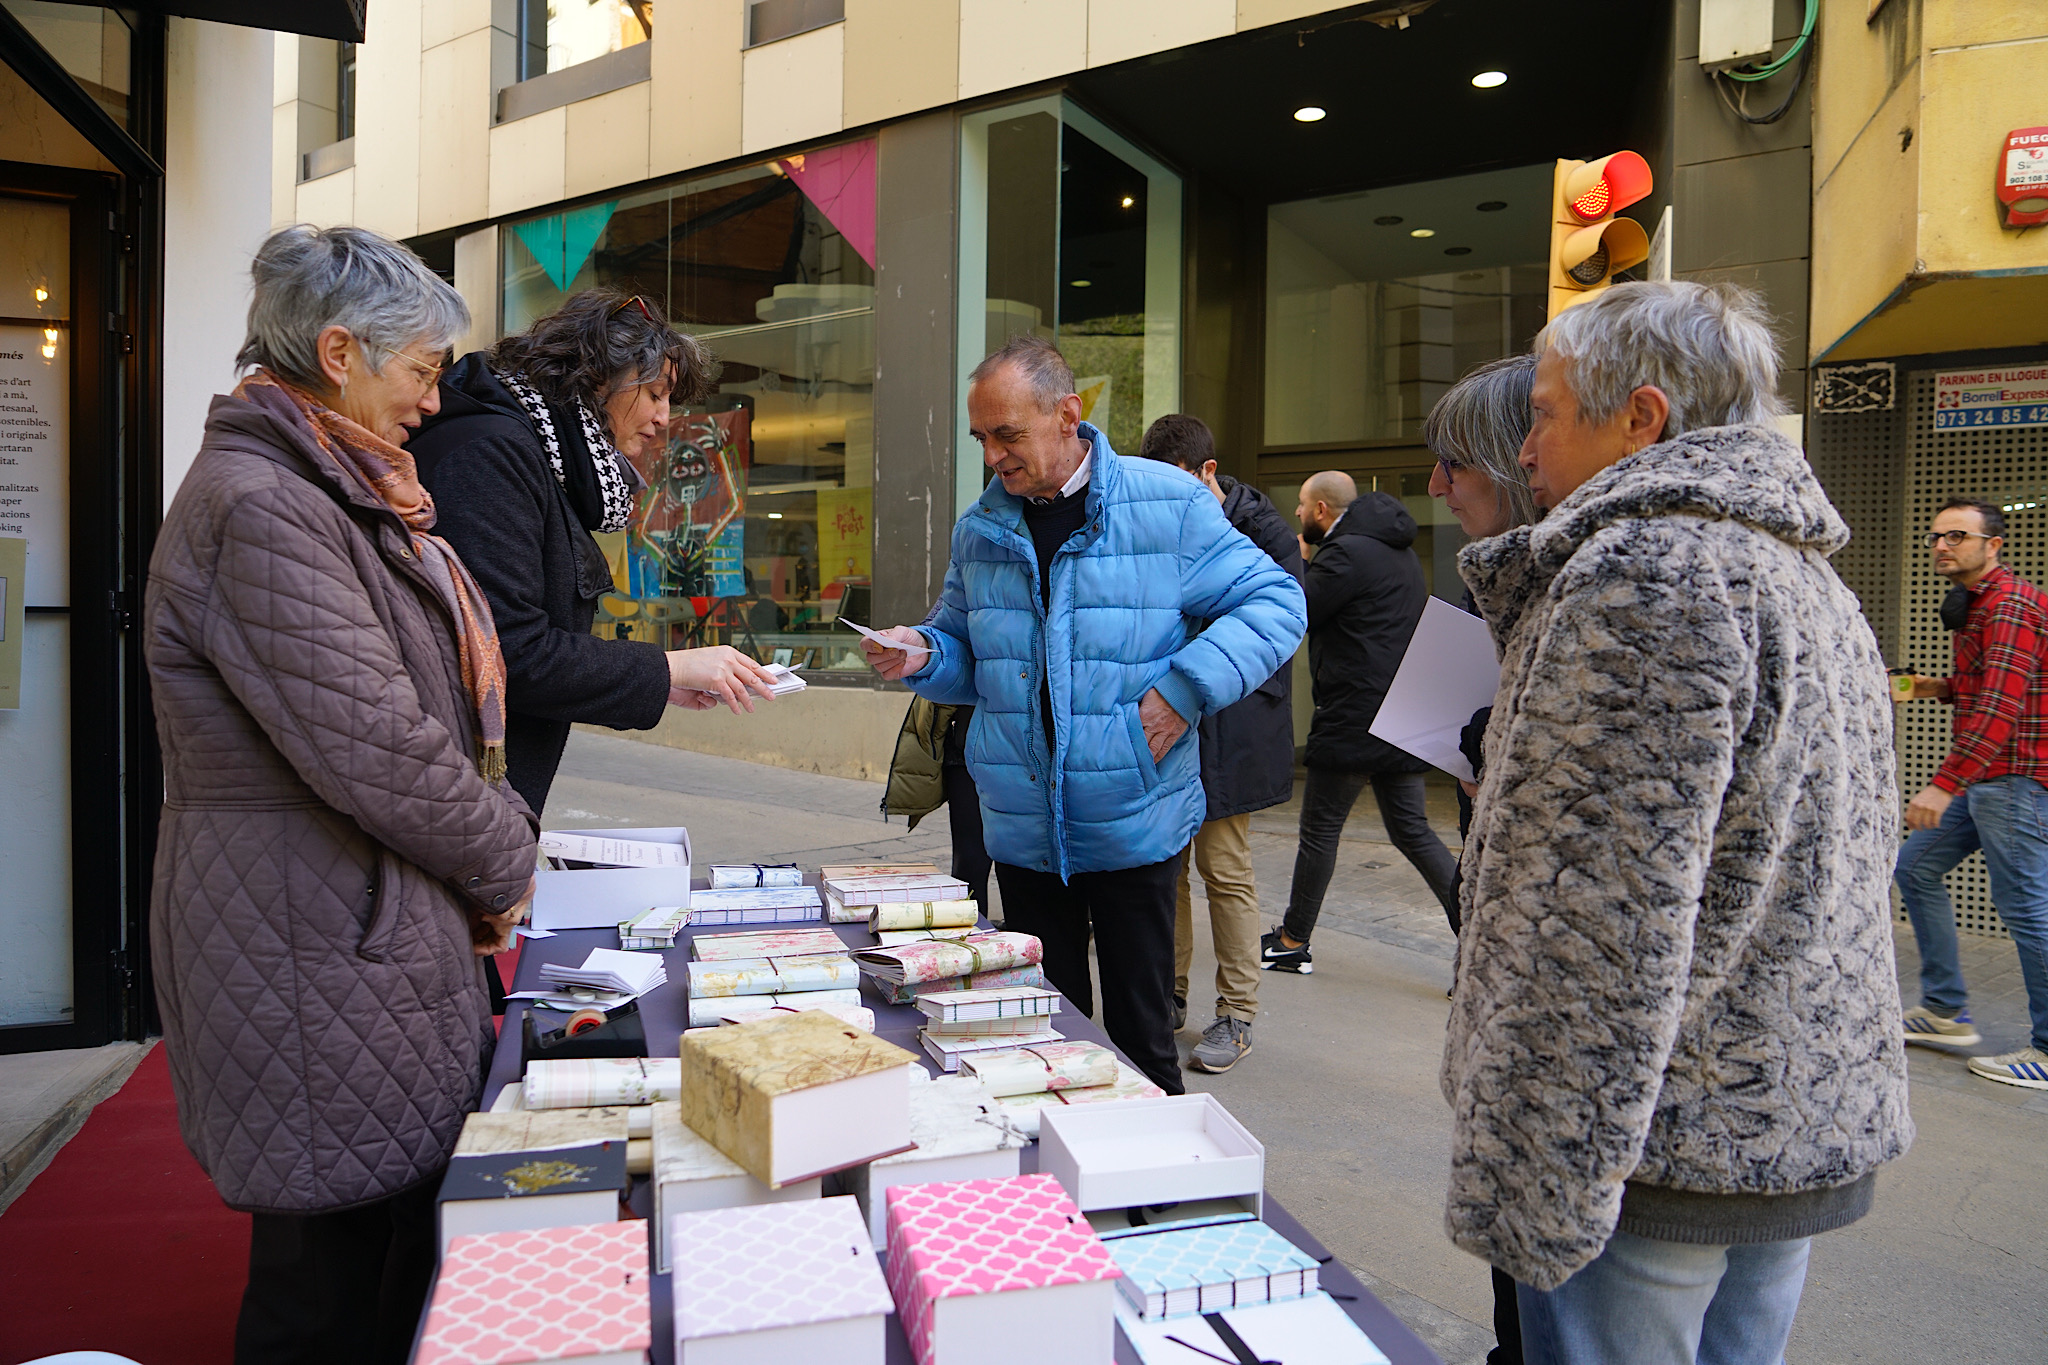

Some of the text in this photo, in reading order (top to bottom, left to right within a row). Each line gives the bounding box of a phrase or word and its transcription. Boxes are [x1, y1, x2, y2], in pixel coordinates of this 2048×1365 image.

[10, 377, 31, 386] d'art
[1939, 369, 2048, 386] PARKING EN LLOGUE
[11, 391, 28, 400] mà,
[1938, 406, 2048, 426] 973 24 85 42
[0, 418, 51, 427] ostenibles.
[6, 431, 47, 441] originals
[0, 498, 22, 507] aper
[0, 523, 22, 533] king
